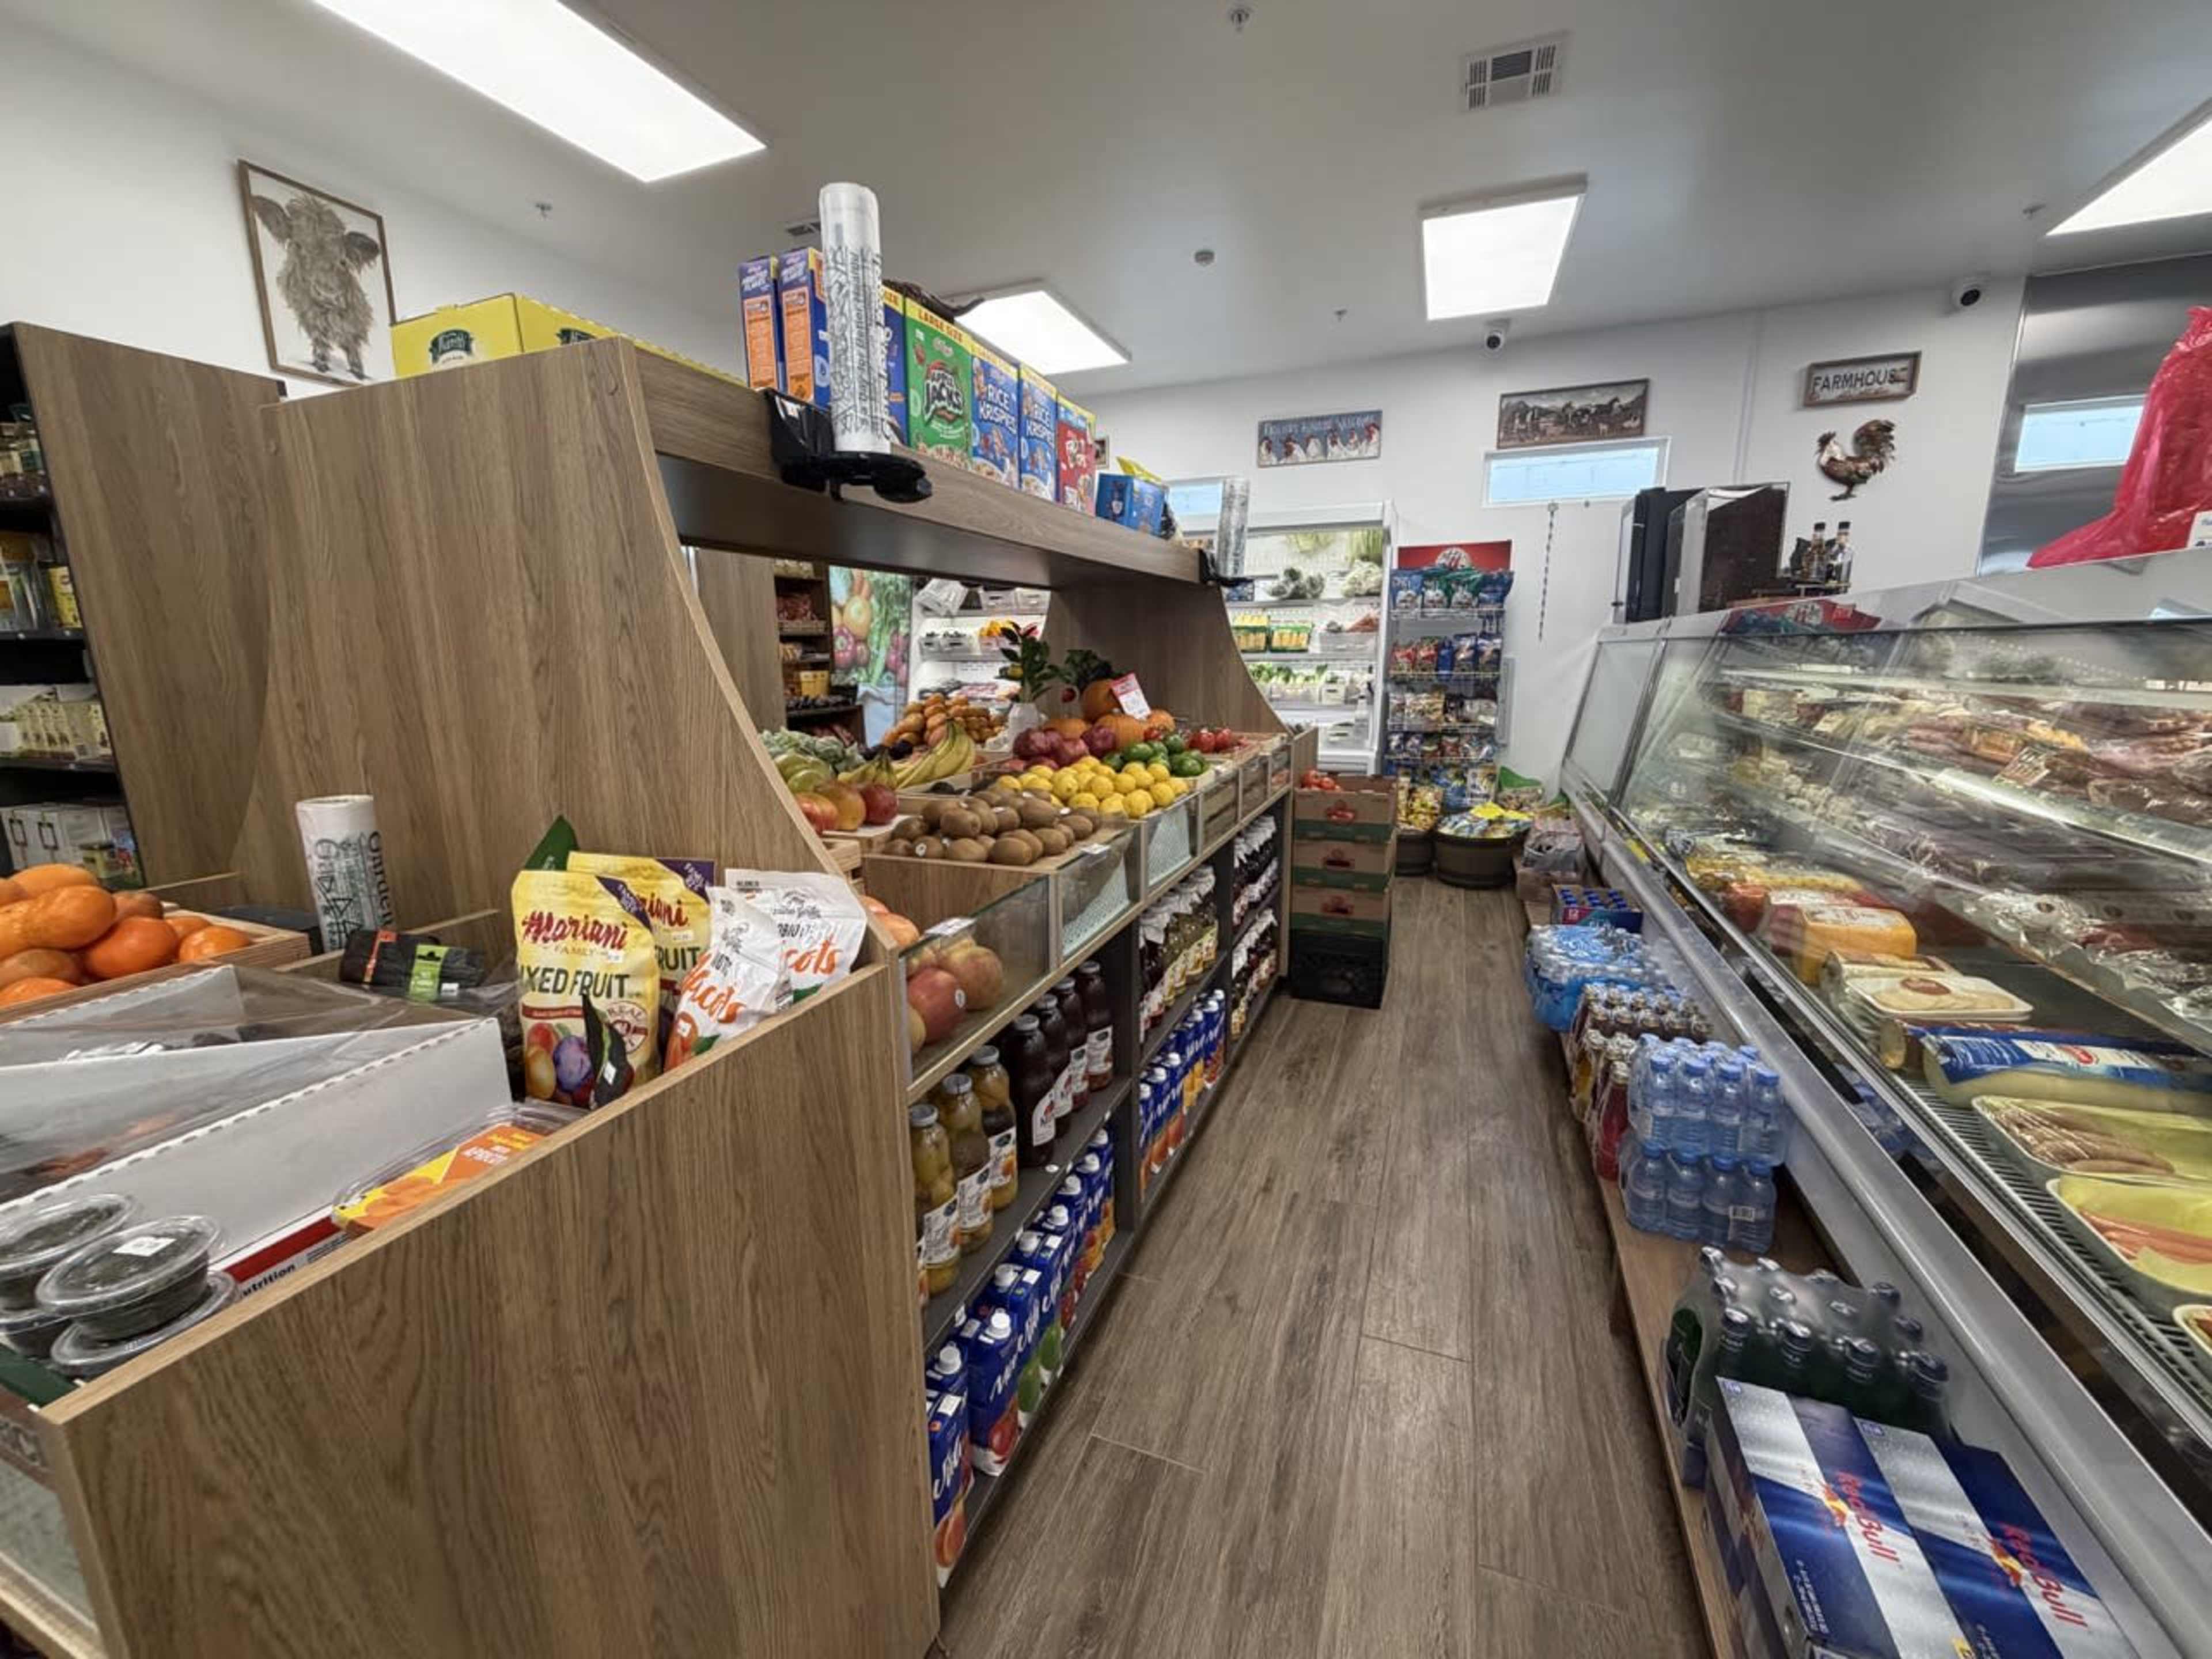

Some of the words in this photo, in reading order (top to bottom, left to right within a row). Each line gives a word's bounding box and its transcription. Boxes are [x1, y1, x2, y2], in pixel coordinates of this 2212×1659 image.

[987, 384, 1010, 410] RICE
[1032, 403, 1051, 427] RICE
[521, 910, 628, 950] Mariani
[569, 971, 630, 999] FRUIT
[241, 1263, 296, 1298] utrition
